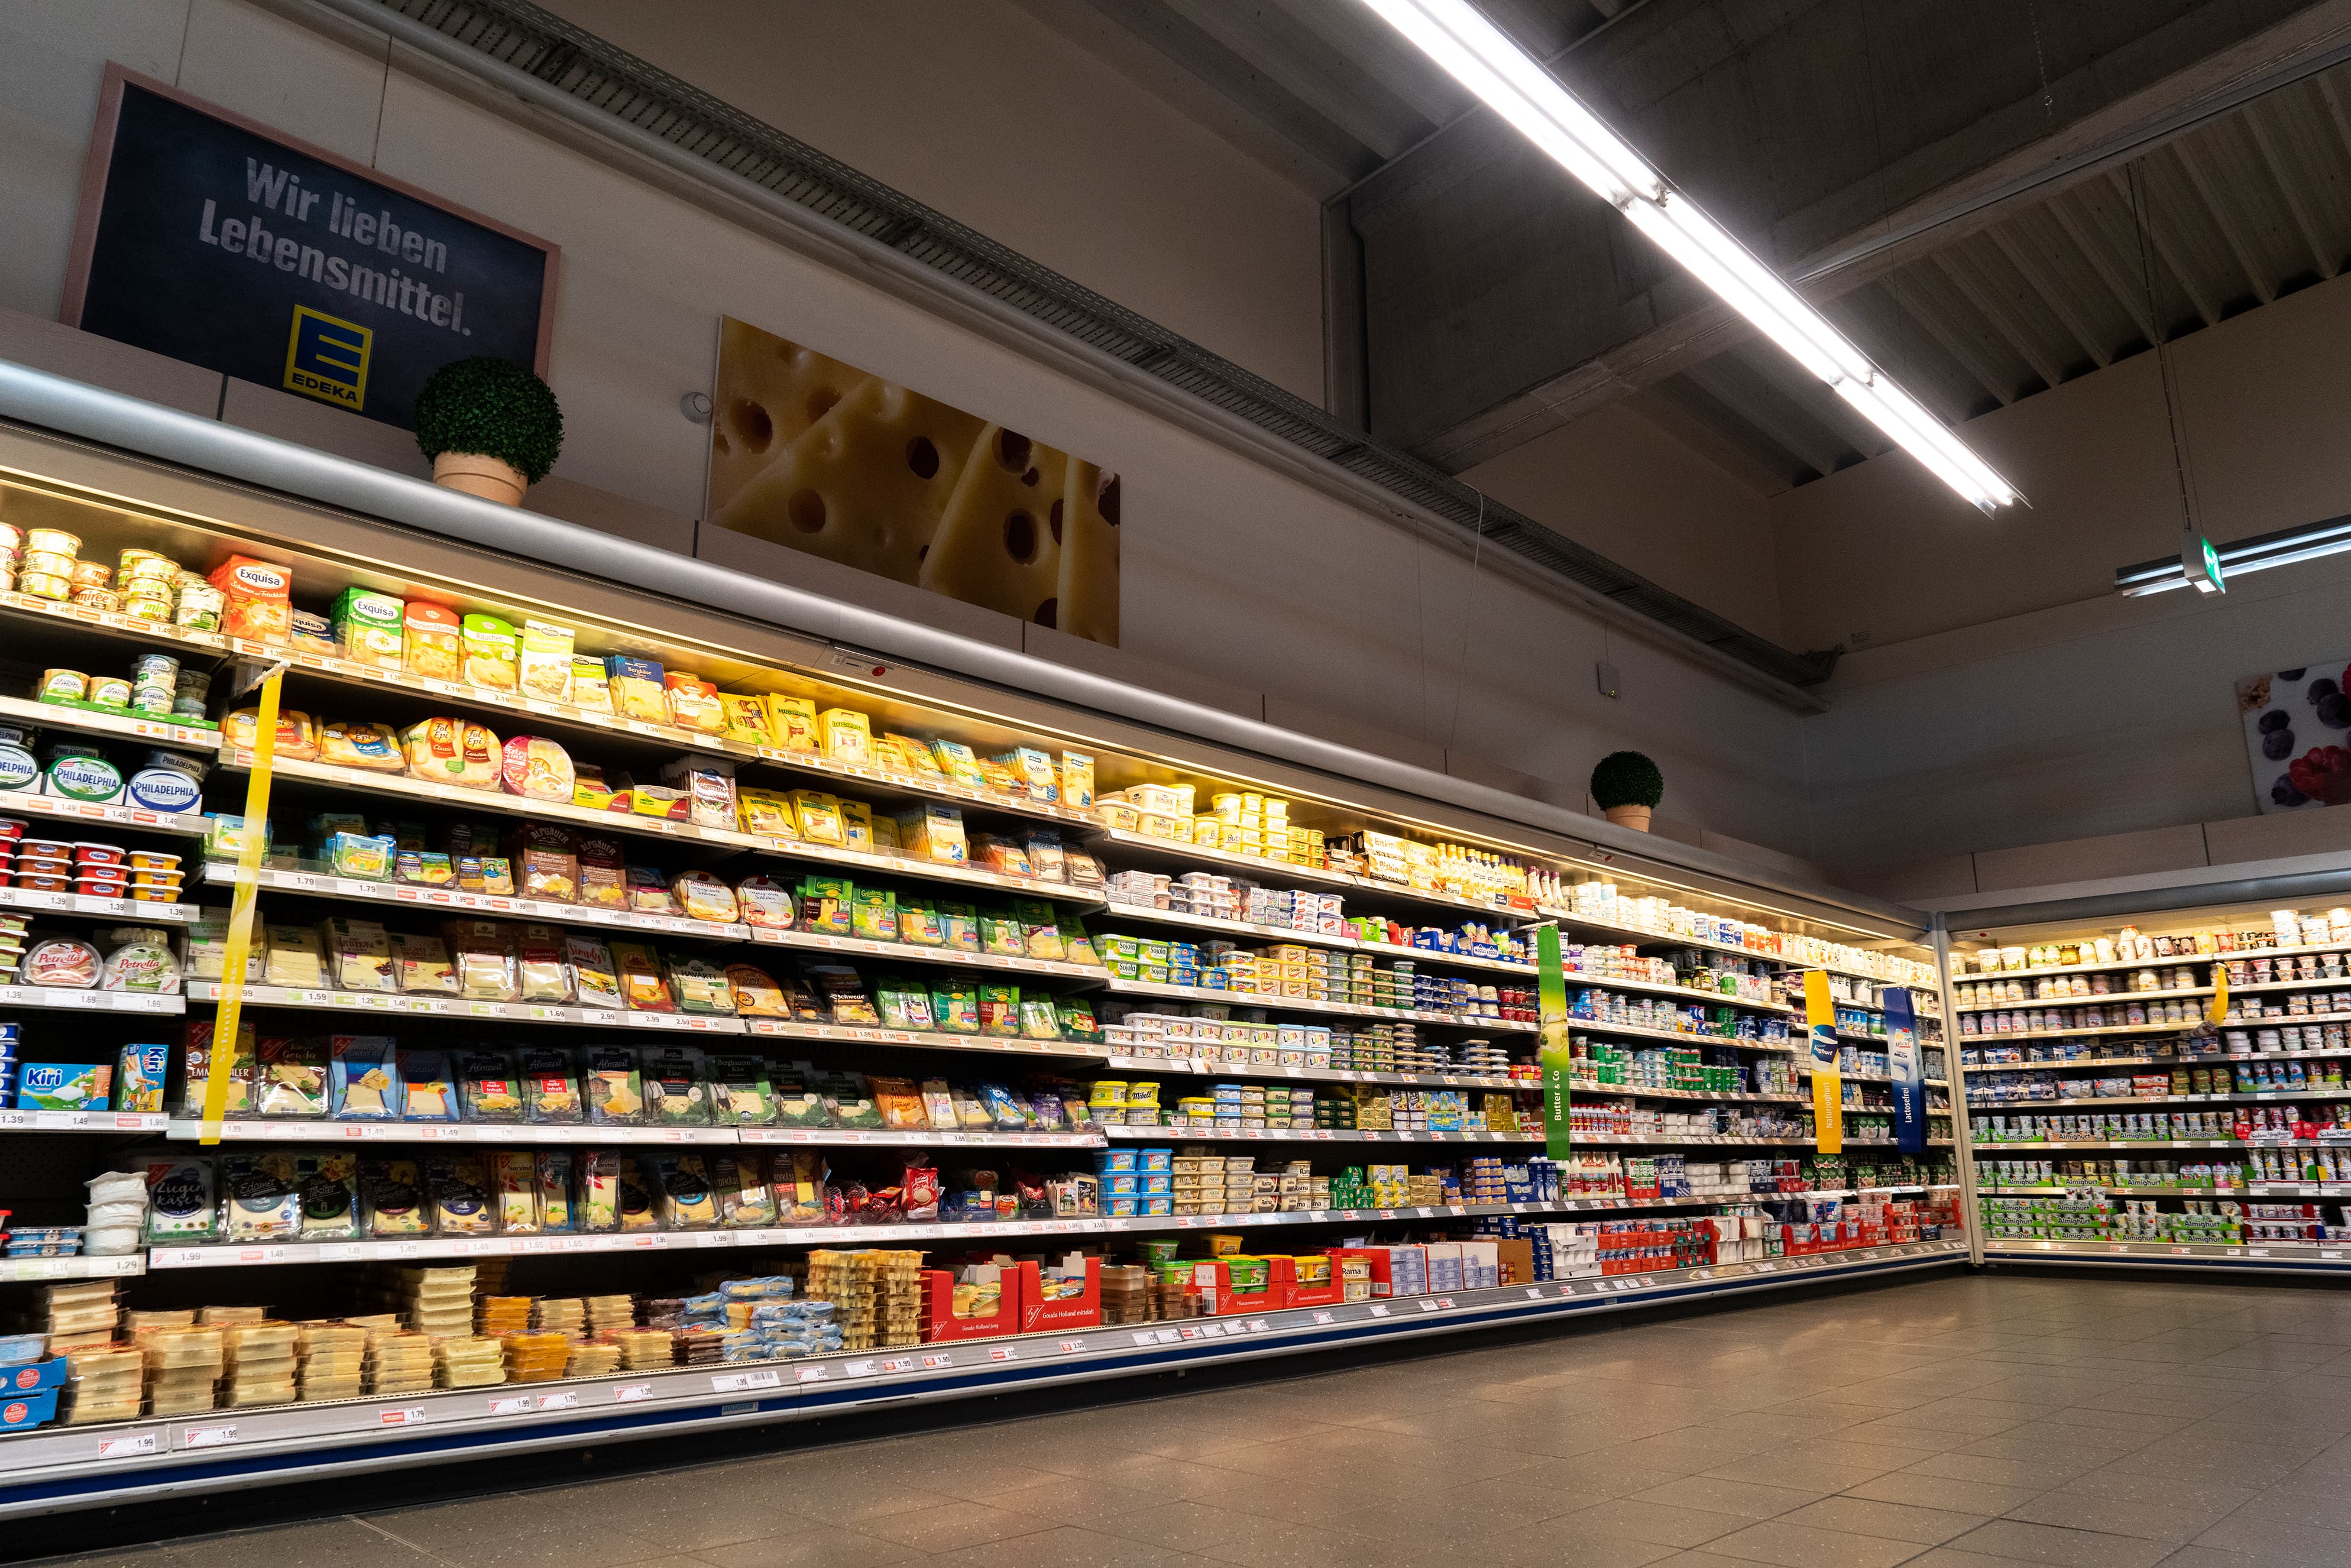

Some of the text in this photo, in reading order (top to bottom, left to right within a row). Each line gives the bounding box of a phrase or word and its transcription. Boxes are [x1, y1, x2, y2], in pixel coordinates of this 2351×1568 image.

[246, 156, 448, 274] Wir lieben
[199, 198, 471, 336] Lebensmittel.
[292, 372, 358, 403] EDEKA
[241, 569, 280, 586] Exquisa
[358, 601, 394, 617] Exquisa
[409, 620, 456, 634] Schinken Räucher
[475, 633, 503, 642] Räucher
[627, 666, 652, 676] Bergkäse
[53, 679, 82, 689] Almette
[778, 708, 811, 720] LEERDAMMER
[434, 722, 449, 733] Fol
[832, 721, 865, 733] LEERDAMMER
[434, 731, 449, 740] Epi
[467, 728, 482, 739] Fol
[467, 737, 483, 747] Epi
[162, 755, 200, 775] PHILADELPHIA
[1028, 765, 1047, 773] Sylter
[57, 768, 117, 788] PHILADELPHIA
[135, 781, 194, 797] PHILADELPHIA
[613, 802, 627, 811] herzhaft
[530, 827, 569, 844] ALPGÄUER
[1375, 837, 1394, 848] Biskin
[580, 840, 616, 856] ALPGÄUER
[1379, 860, 1399, 873] Biskin
[296, 877, 314, 886] 1.79
[686, 878, 724, 890] Géramont
[817, 882, 842, 890] Grünländer
[861, 889, 885, 898] Grünländer
[1119, 942, 1135, 952] Sojola
[1149, 947, 1166, 956] Sojola
[568, 943, 601, 964] Simply
[38, 953, 82, 965] Petrella
[119, 958, 160, 971] Petrella
[1119, 963, 1135, 972] Sojola
[681, 970, 717, 980] HAVARTI
[1151, 966, 1166, 976] Sojola
[106, 976, 123, 990] Petrella
[6, 990, 21, 999] 1.39
[309, 993, 327, 1001] 1.59
[81, 996, 96, 1004] 1.69
[601, 1012, 615, 1021] 2.99
[646, 1015, 659, 1023] 2.99
[1166, 1025, 1183, 1036] LÄTTA
[1228, 1030, 1243, 1041] LÄTTA
[1254, 1032, 1270, 1042] LÄTTA
[1283, 1032, 1298, 1042] LÄTTA
[1814, 1045, 1833, 1055] Joghurt
[147, 1047, 165, 1074] Kiri
[597, 1058, 627, 1069] Almzeit
[717, 1058, 751, 1067] Bergbauern
[27, 1068, 63, 1087] Kiri
[192, 1068, 249, 1077] EMMALER
[1553, 1070, 1559, 1081] Co
[1555, 1083, 1560, 1093] &
[1823, 1082, 1833, 1128] Naturjoghurt
[1902, 1088, 1912, 1123] Lactosefrei
[73, 1117, 88, 1125] 1.49
[773, 1173, 795, 1182] HOFKÄSE
[2066, 1178, 2098, 1186] Almighurt
[156, 1182, 204, 1195] Ziegen
[239, 1178, 276, 1194] Edamer
[567, 1240, 582, 1248] 1.65
[713, 1235, 727, 1243] 1.99
[399, 1245, 417, 1253] 1.49
[528, 1242, 544, 1250] 1.65
[181, 1252, 200, 1261] 1.99
[270, 1249, 284, 1258] 1.49
[117, 1261, 137, 1269] 1.29
[565, 1395, 577, 1403] 1.79
[411, 1410, 425, 1418] 1.79
[222, 1430, 237, 1439] 1.99
[137, 1439, 153, 1448] 1.99
